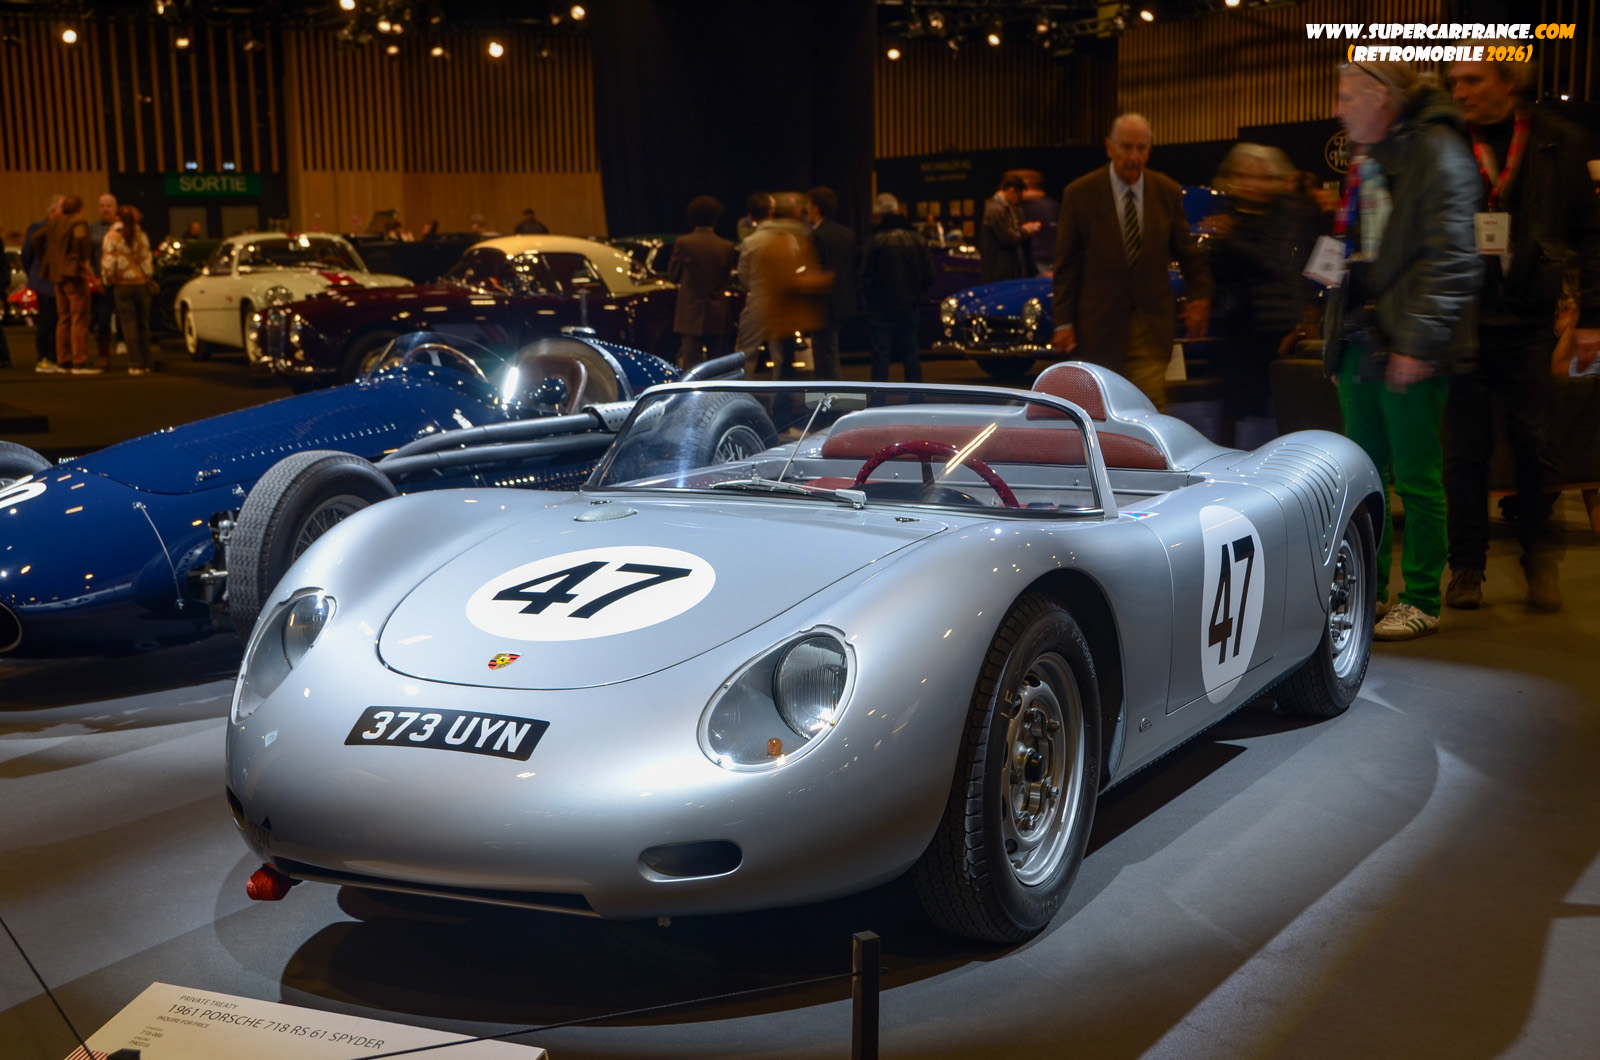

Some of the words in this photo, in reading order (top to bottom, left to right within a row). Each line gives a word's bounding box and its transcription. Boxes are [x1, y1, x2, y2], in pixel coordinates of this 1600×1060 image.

[179, 174, 247, 192] SORTIE
[491, 561, 693, 619] 47
[1208, 534, 1256, 665] 47
[362, 711, 442, 742] 373
[444, 715, 532, 753] UYN
[157, 1015, 181, 1024] INQUIRE
[192, 1020, 211, 1029] PRICE
[179, 995, 211, 1006] PRIVATE
[210, 1000, 239, 1010] TREATY
[168, 1004, 199, 1017] 1961
[199, 1009, 265, 1028] PORSCHE
[264, 1020, 291, 1033] 718
[290, 1025, 311, 1036] RS
[309, 1029, 328, 1040] 61
[328, 1032, 385, 1050] SPYDER
